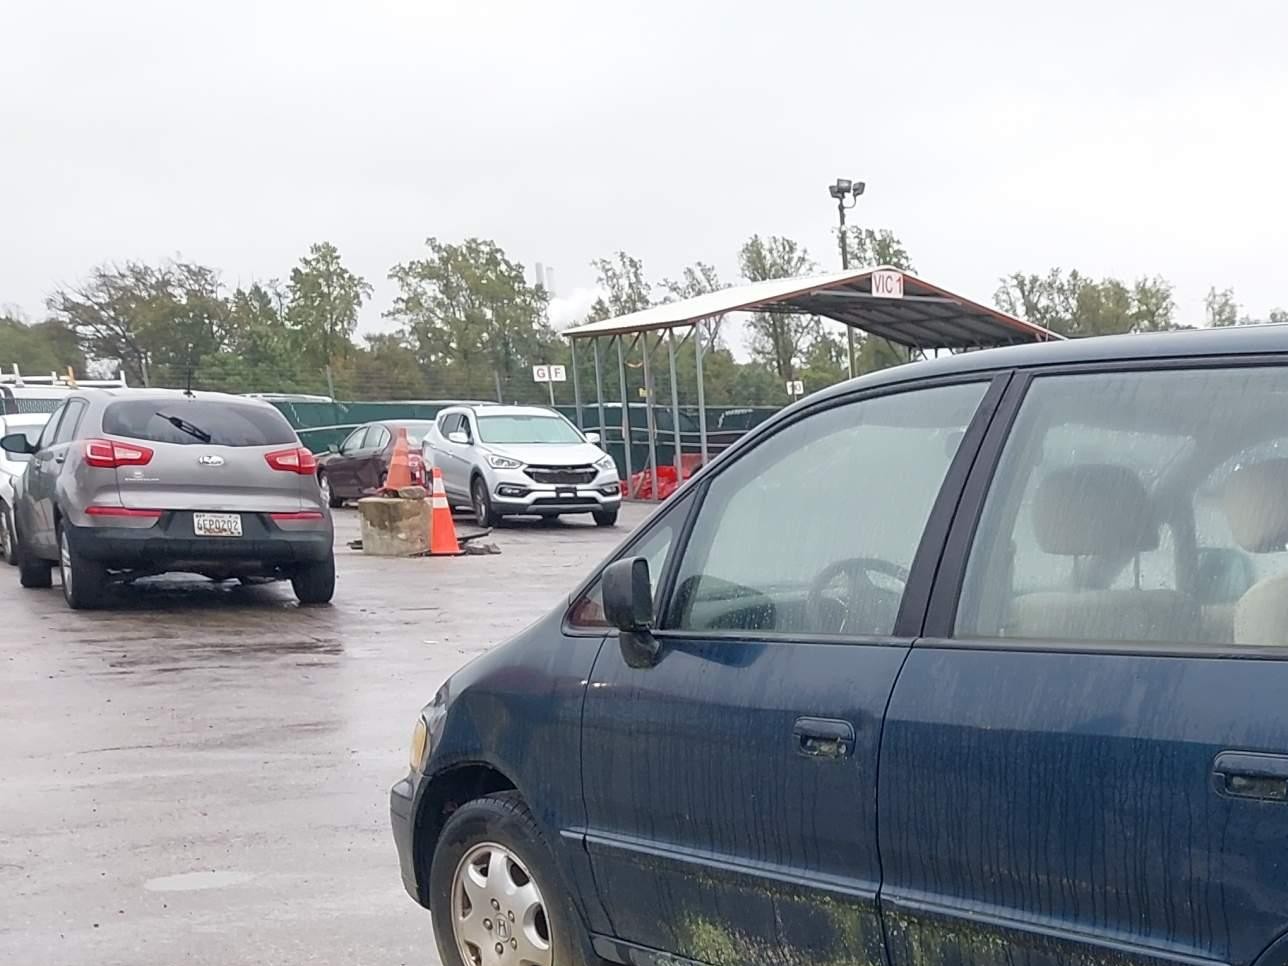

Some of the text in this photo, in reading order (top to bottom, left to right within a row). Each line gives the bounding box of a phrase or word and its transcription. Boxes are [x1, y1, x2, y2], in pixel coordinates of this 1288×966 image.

[873, 274, 902, 294] VIC 1
[536, 367, 561, 378] G F
